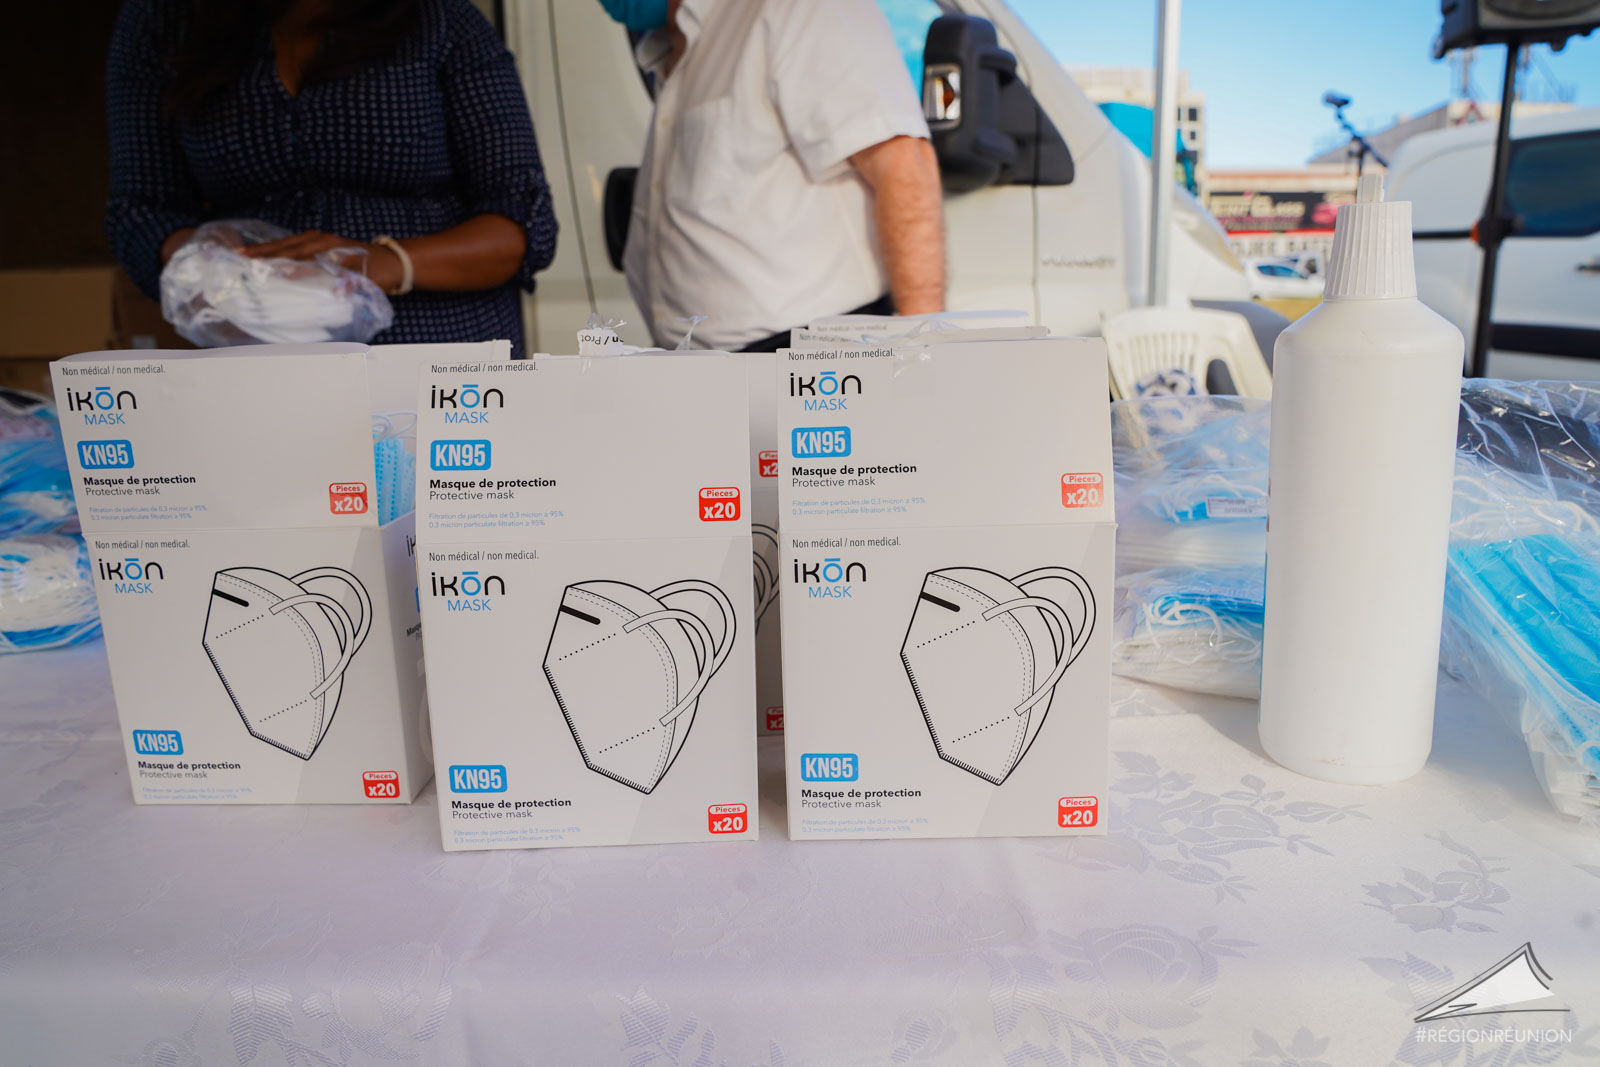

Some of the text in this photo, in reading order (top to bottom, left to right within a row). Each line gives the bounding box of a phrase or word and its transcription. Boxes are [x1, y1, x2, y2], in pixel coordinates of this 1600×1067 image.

[788, 351, 805, 361] Non
[806, 350, 838, 360] médical
[844, 351, 860, 359] non
[861, 348, 895, 358] medical.
[62, 366, 79, 376] Non
[81, 365, 111, 376] médical
[116, 367, 132, 375] non
[133, 363, 166, 374] medical.
[430, 364, 448, 374] Non
[449, 362, 481, 373] médical
[487, 364, 503, 372] non
[504, 361, 539, 372] medical.
[804, 398, 848, 411] MASK
[84, 413, 125, 425] MASK
[444, 412, 489, 424] MASK
[796, 430, 846, 454] KN95
[81, 444, 129, 465] KN95
[435, 443, 486, 467] KN95
[763, 462, 778, 475] x2
[791, 463, 917, 478] Masque de protection
[82, 474, 196, 487] Masque de protection
[429, 477, 556, 491] Masque de protection
[792, 475, 876, 488] Protective mask
[1068, 475, 1097, 483] Pieces
[84, 486, 161, 496] Protective mask
[335, 484, 361, 493] Pieces
[429, 489, 515, 501] Protective mask
[706, 489, 733, 498] Pieces
[1066, 488, 1099, 505] x20
[333, 497, 364, 513] x20
[703, 502, 736, 519] x20
[94, 540, 110, 549] Non
[111, 539, 139, 549] médical
[144, 541, 159, 549] non
[160, 538, 191, 549] medical.
[792, 538, 809, 549] Non
[810, 537, 843, 548] médical
[849, 539, 865, 547] non
[867, 536, 901, 547] medical.
[428, 552, 446, 562] Non
[447, 550, 480, 561] médical
[486, 552, 503, 561] non
[504, 550, 539, 560] medical.
[115, 583, 153, 593] MASK
[808, 586, 852, 598] MASK
[447, 599, 492, 612] MASK
[136, 733, 179, 752] KN95
[137, 760, 241, 773] Masque de protection
[805, 757, 854, 778] KN95
[138, 769, 208, 779] Protective mask
[453, 768, 502, 789] KN95
[368, 783, 396, 797] x20
[801, 789, 922, 801] Masque de protection
[451, 797, 572, 812] Masque de protection
[801, 799, 882, 808] Protective mask
[1065, 798, 1091, 806] Pieces
[451, 808, 533, 820] Protective mask
[1062, 811, 1093, 826] x20
[712, 817, 743, 832] x20
